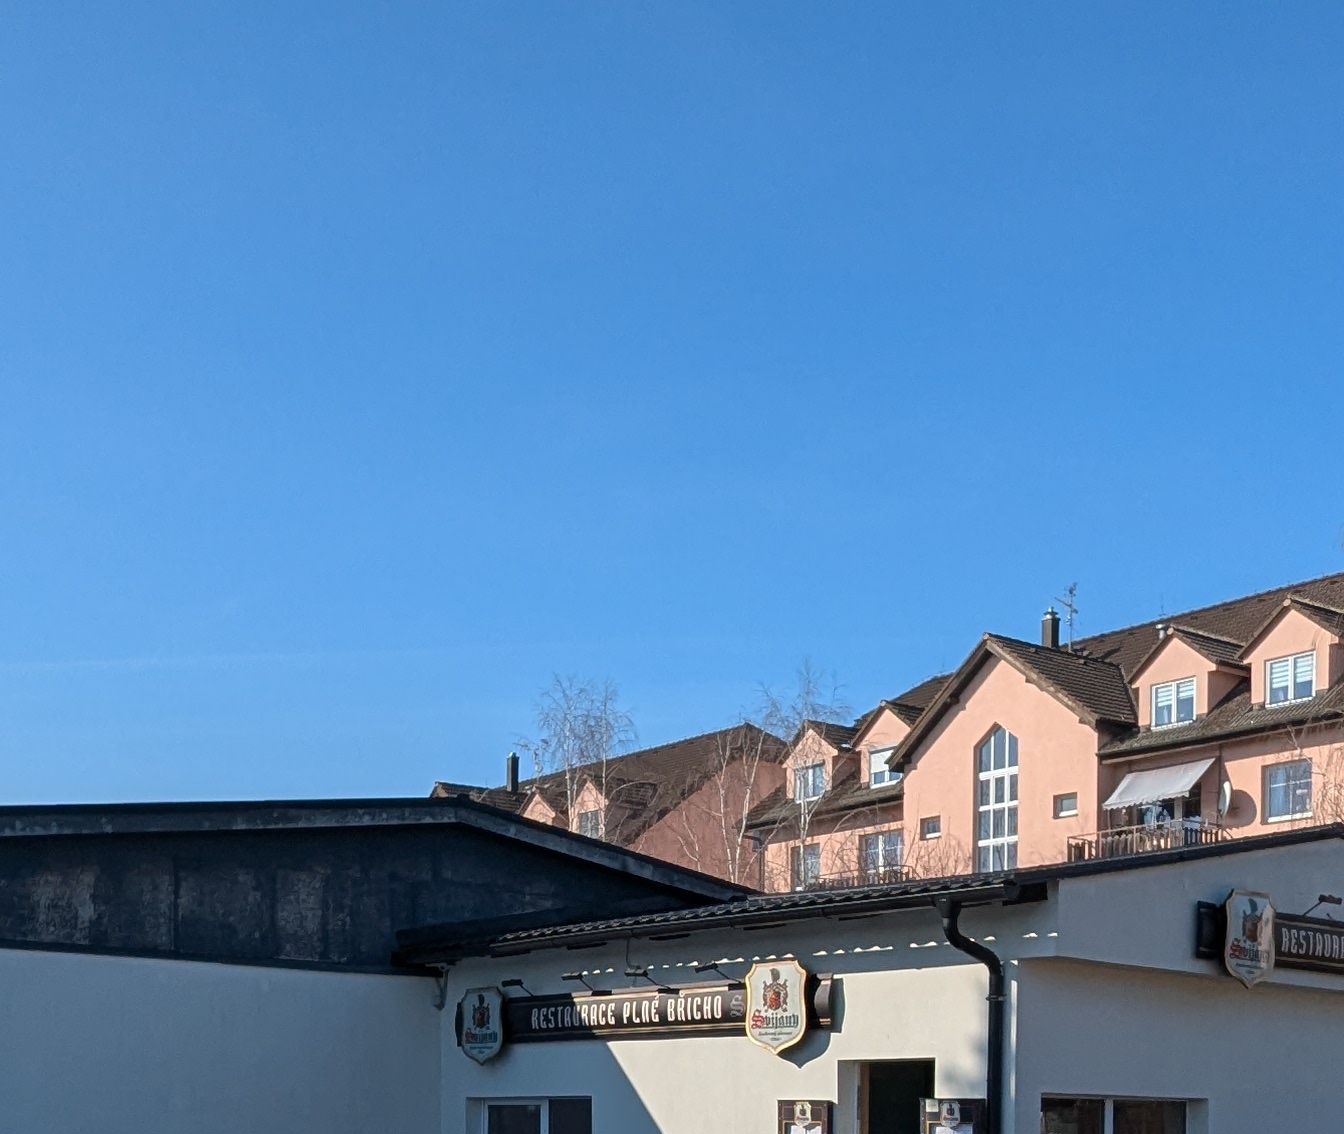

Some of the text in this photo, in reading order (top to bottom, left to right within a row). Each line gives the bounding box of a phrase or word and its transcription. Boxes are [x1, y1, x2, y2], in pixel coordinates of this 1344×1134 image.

[531, 1002, 616, 1030] RESTAURACE
[622, 994, 660, 1024] PLNÉ
[667, 991, 723, 1022] BŘICHO
[751, 1008, 799, 1030] Svijany
